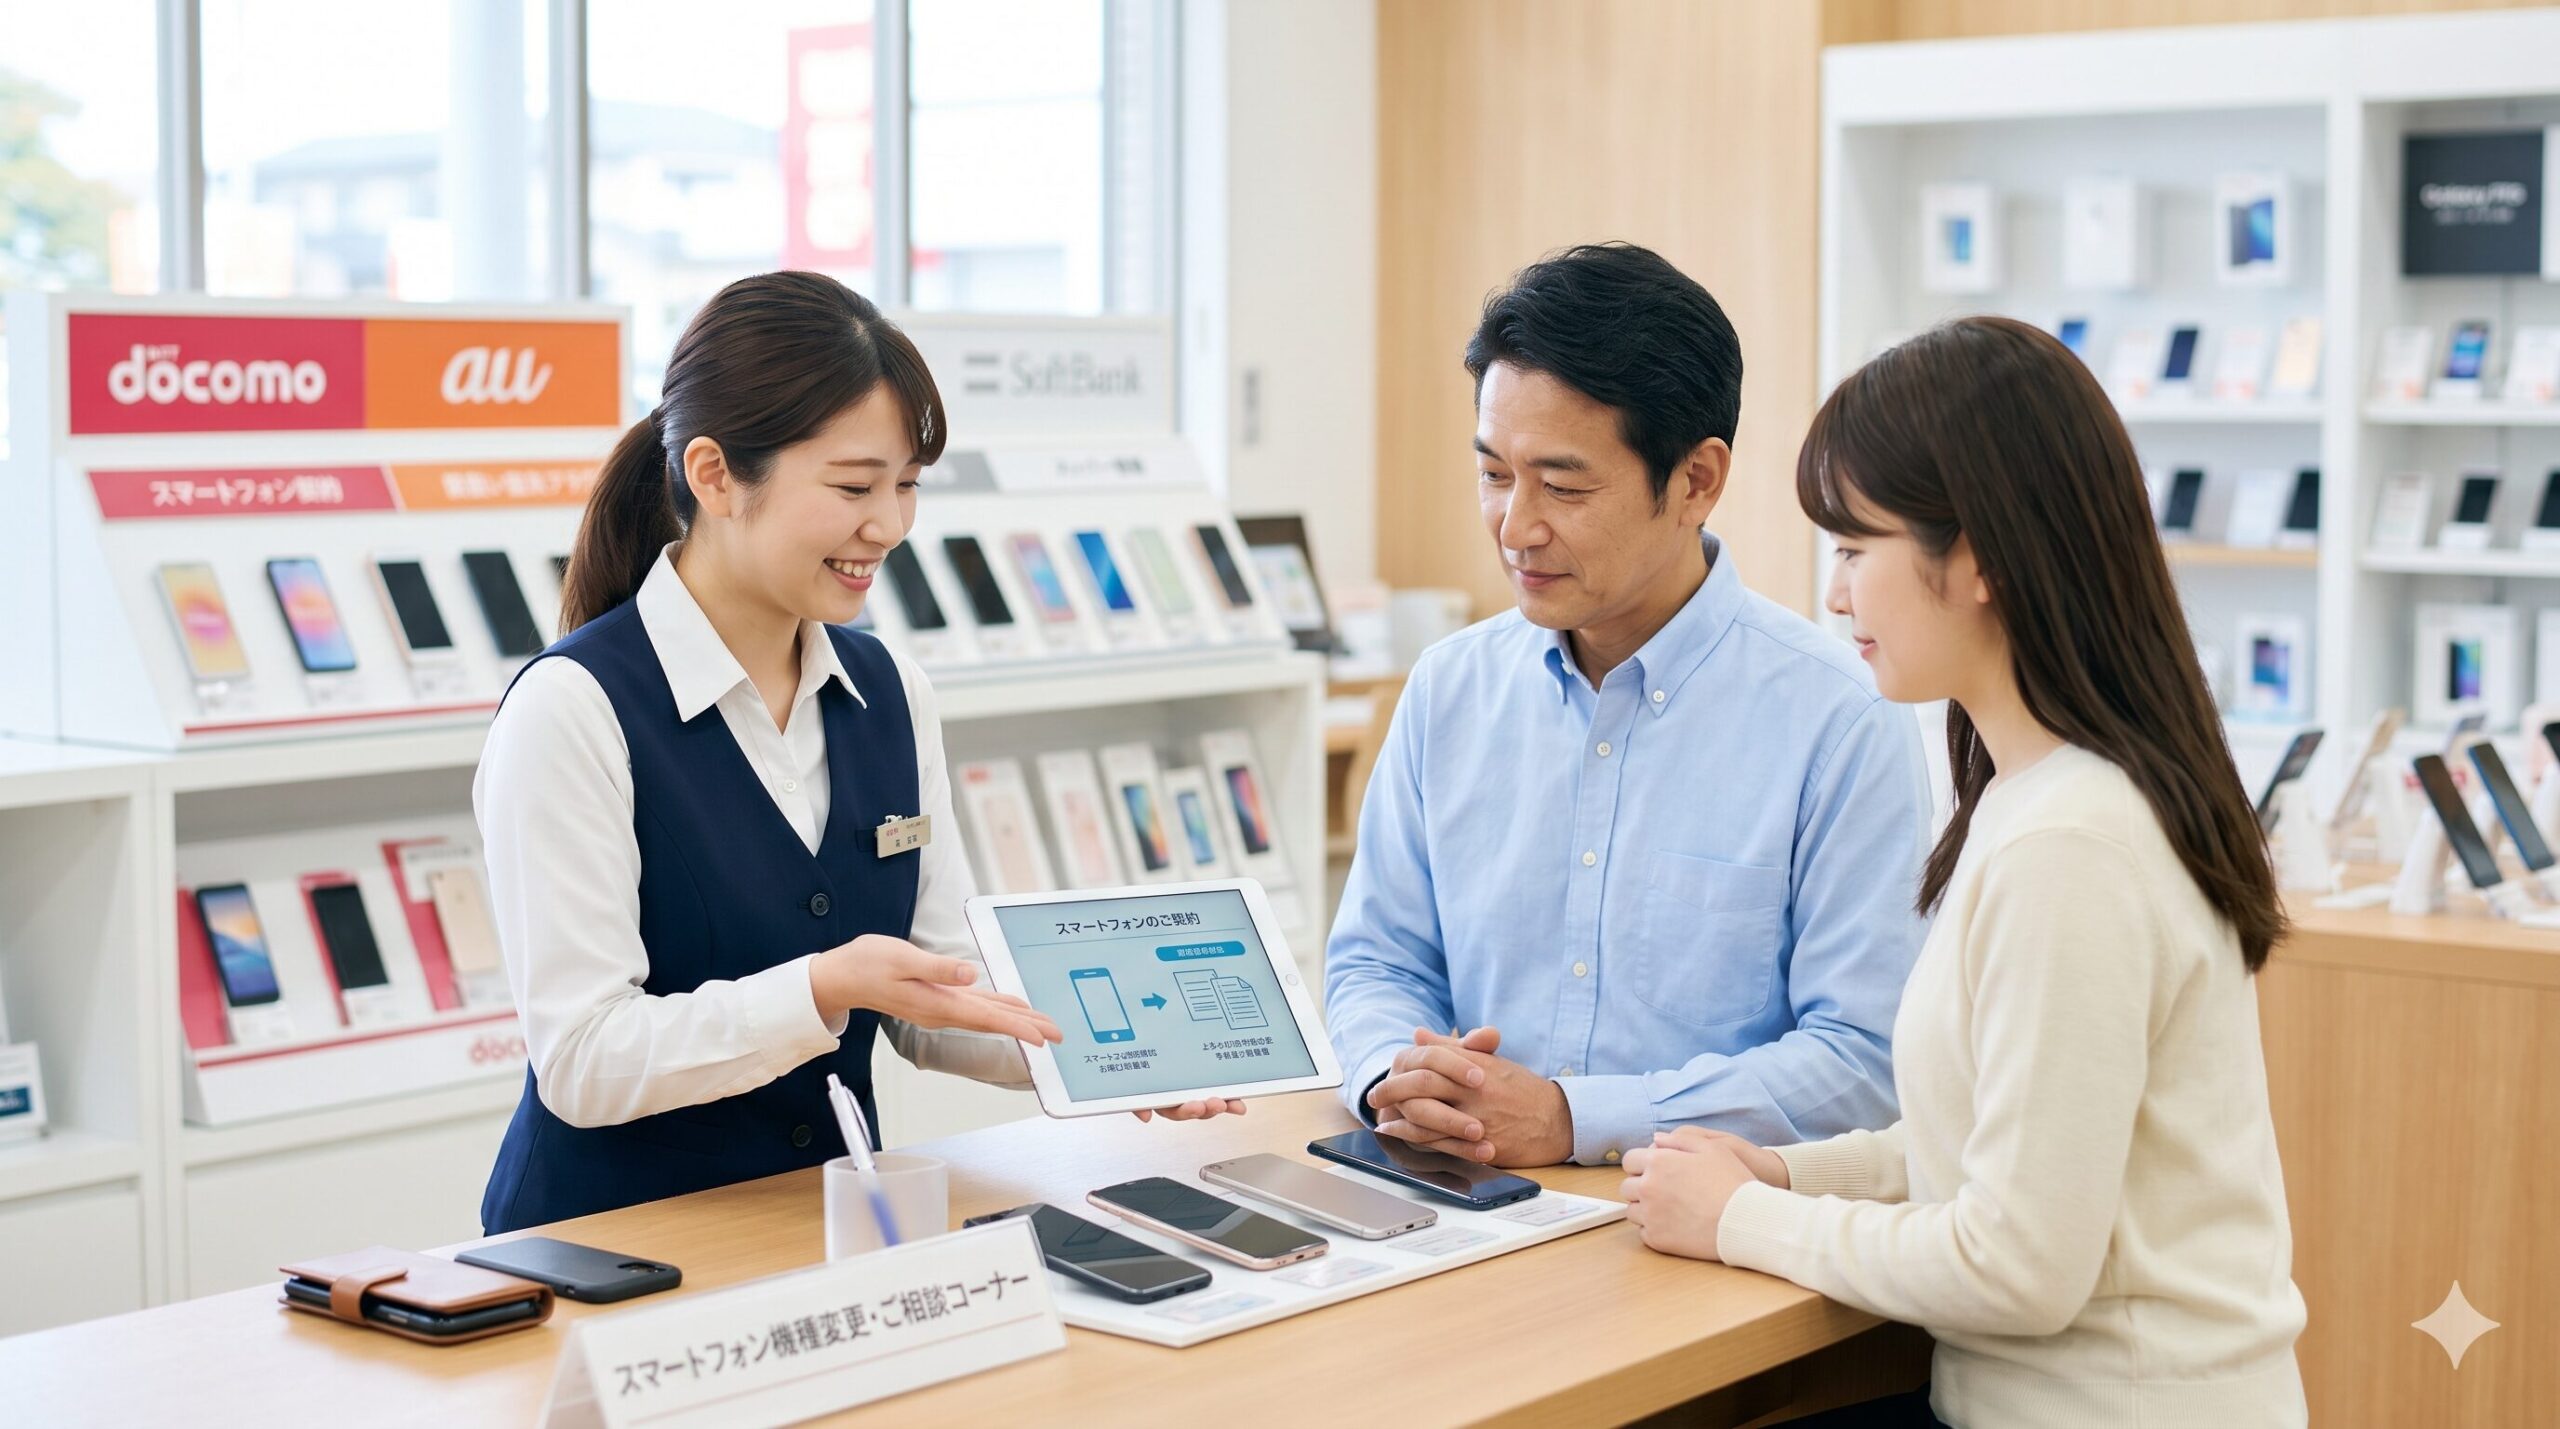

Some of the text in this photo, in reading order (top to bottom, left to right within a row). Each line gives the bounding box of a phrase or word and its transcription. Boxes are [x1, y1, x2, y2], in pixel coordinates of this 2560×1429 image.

[107, 343, 328, 405] docomo
[440, 345, 553, 404] au
[614, 1270, 1029, 1396] スマートフォン機種変更・ご相談コーナー
